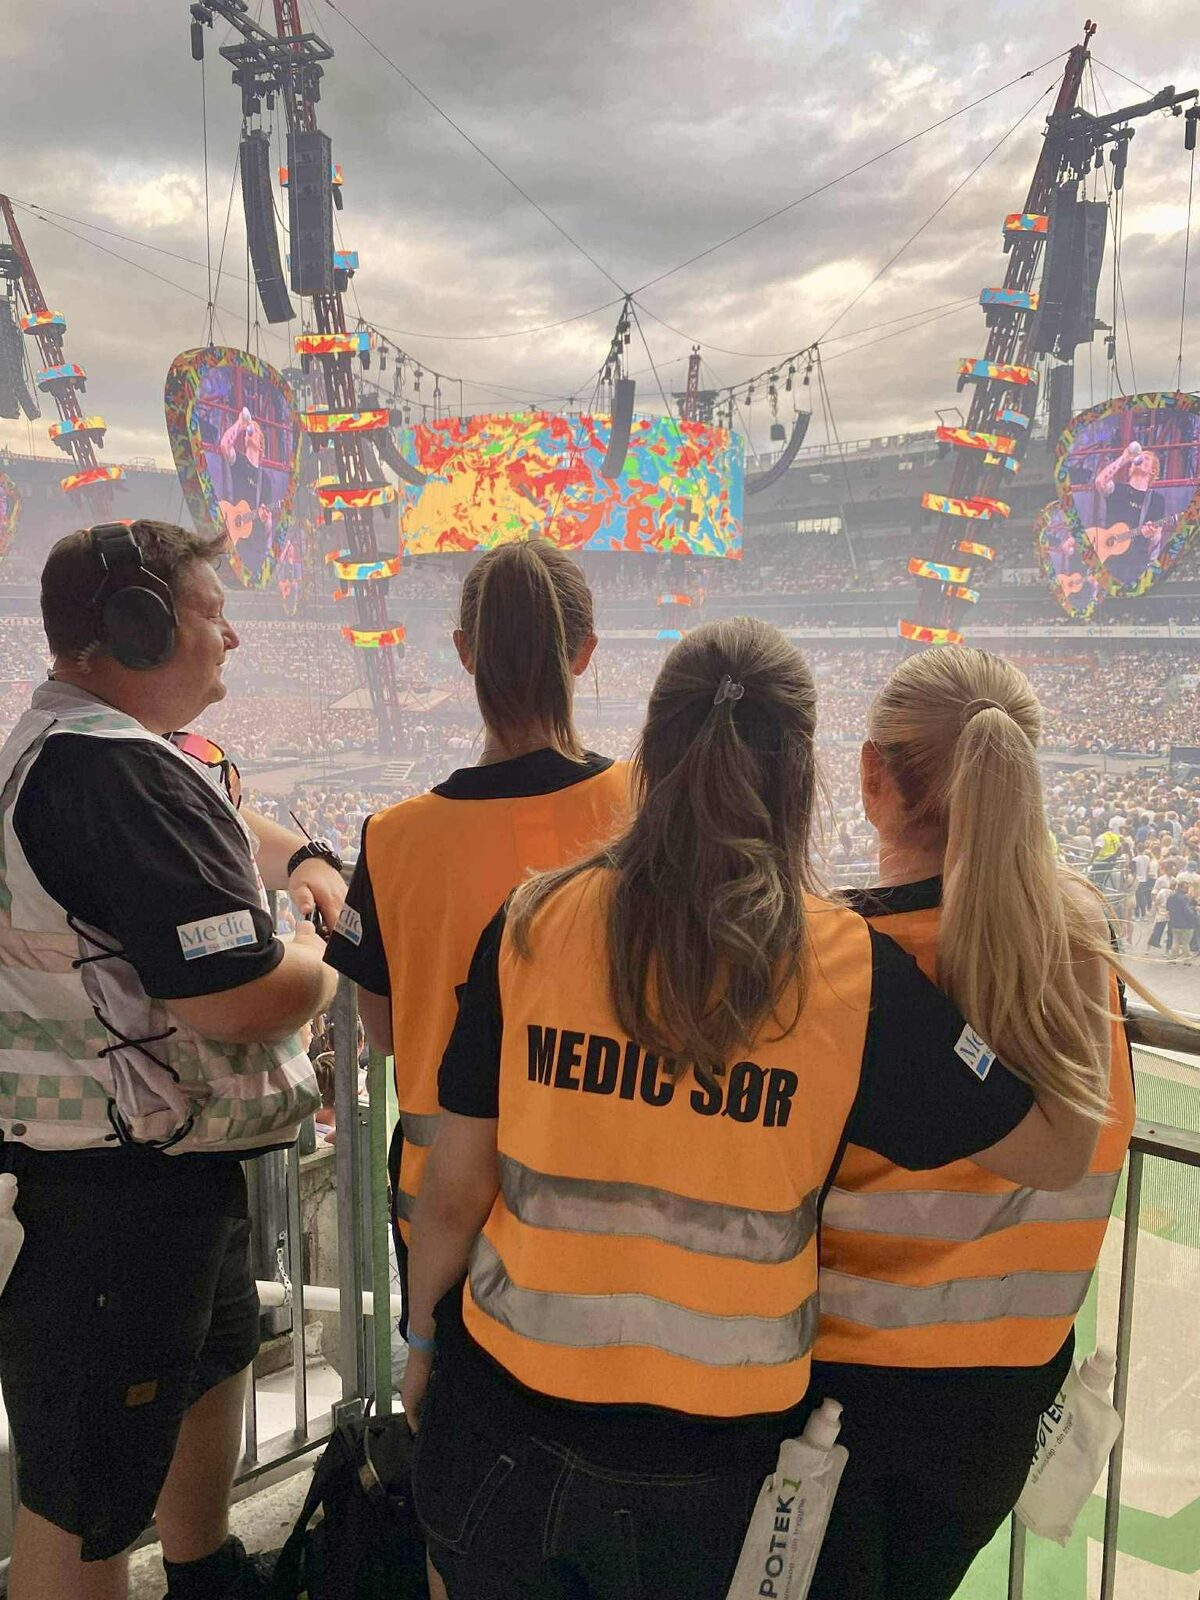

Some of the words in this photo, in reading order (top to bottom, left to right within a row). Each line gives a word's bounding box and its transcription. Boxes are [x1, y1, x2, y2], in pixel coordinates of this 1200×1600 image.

[180, 916, 249, 948] Medic
[338, 908, 361, 935] dic
[527, 1024, 676, 1107] MEDIC
[689, 1059, 799, 1127] SØR
